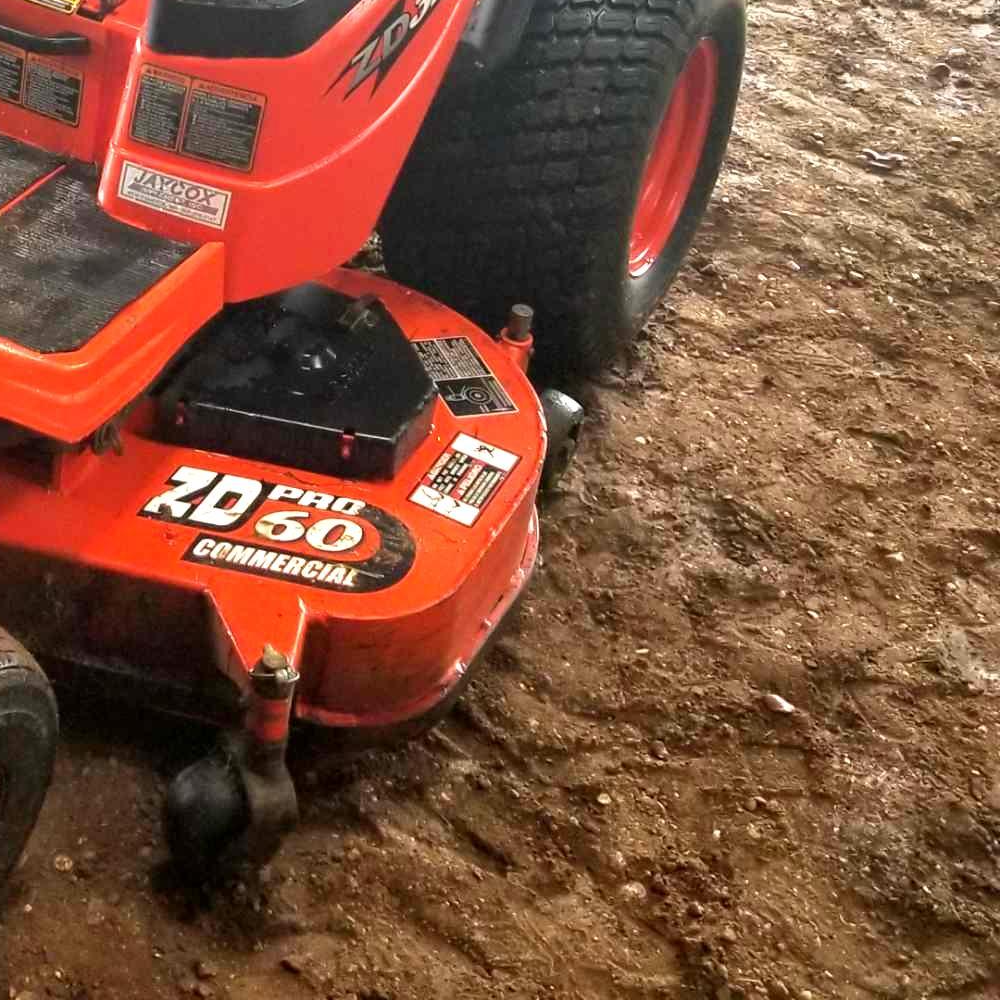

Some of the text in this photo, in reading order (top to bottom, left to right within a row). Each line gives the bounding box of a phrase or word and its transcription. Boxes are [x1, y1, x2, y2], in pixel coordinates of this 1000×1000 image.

[133, 169, 216, 206] JAYCOX
[143, 465, 366, 526] ZD PRO
[254, 510, 364, 552] 60
[192, 537, 362, 587] COMMERCIAL
